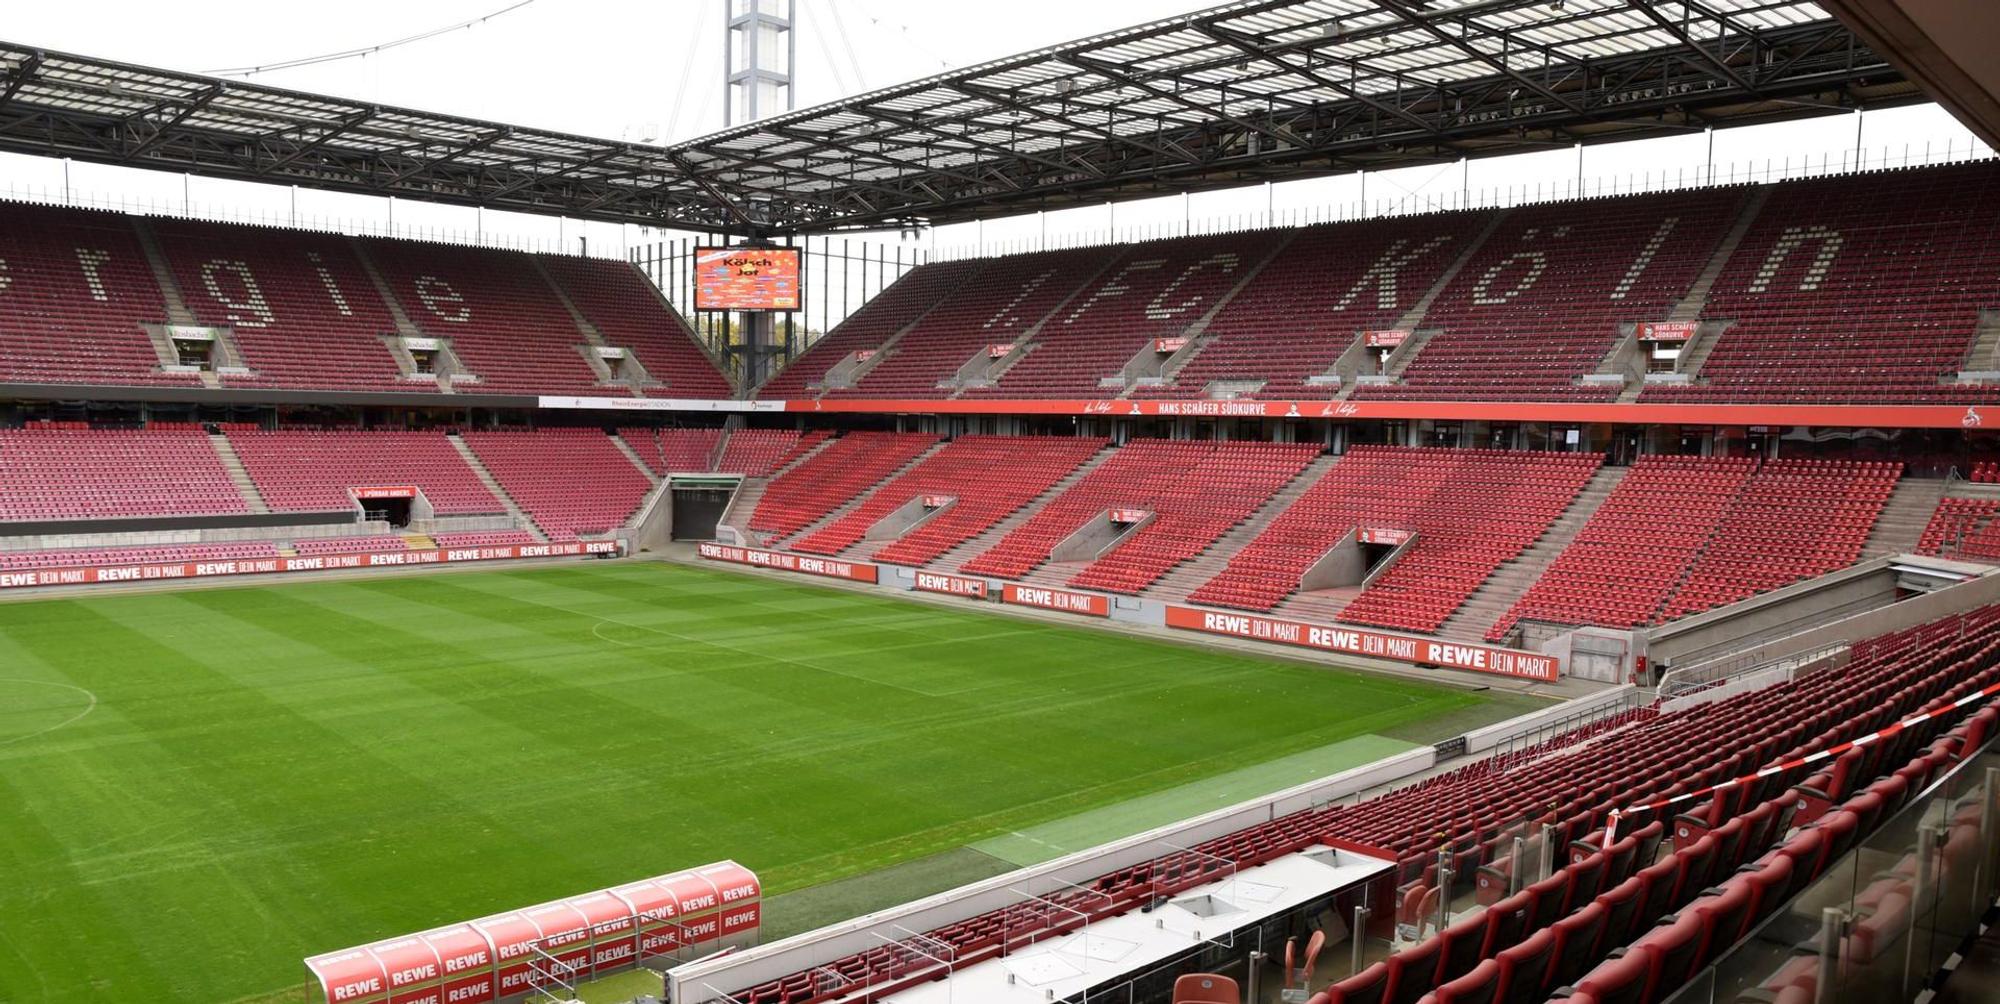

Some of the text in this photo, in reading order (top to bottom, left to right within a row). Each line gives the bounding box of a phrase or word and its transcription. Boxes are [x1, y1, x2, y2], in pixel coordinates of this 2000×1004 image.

[1064, 253, 1240, 320] FC
[1333, 217, 1843, 310] Köln
[1159, 401, 1266, 415] HANS SCHÄFER SÜDKURVE
[447, 549, 480, 561] REWE
[520, 545, 550, 556] REWE
[586, 542, 615, 553] REWE
[701, 544, 721, 558] REWE
[287, 557, 323, 570] REWE
[370, 553, 405, 565] REWE
[747, 551, 770, 564] REWE
[799, 558, 824, 573] REWE
[97, 567, 142, 581] REWE
[196, 562, 237, 574] REWE
[918, 573, 949, 591] REWE
[950, 578, 965, 592] DEIN
[1016, 587, 1091, 611] REWE DEIN MARKT
[1205, 612, 1301, 642] REWE DEIN MARKT
[1309, 627, 1417, 658] REWE DEIN MARKT
[1428, 645, 1552, 678] REWE DEIN MARKT
[723, 885, 756, 901] REWE
[682, 894, 716, 912] REWE
[640, 905, 675, 923] REWE
[725, 910, 756, 928] REWE
[684, 921, 716, 939] REWE
[643, 932, 677, 950] REWE
[445, 951, 488, 972] REWE
[596, 944, 632, 962] REWE
[392, 964, 437, 986] REWE
[334, 978, 381, 1000] REWE
[449, 981, 490, 1002] REWE
